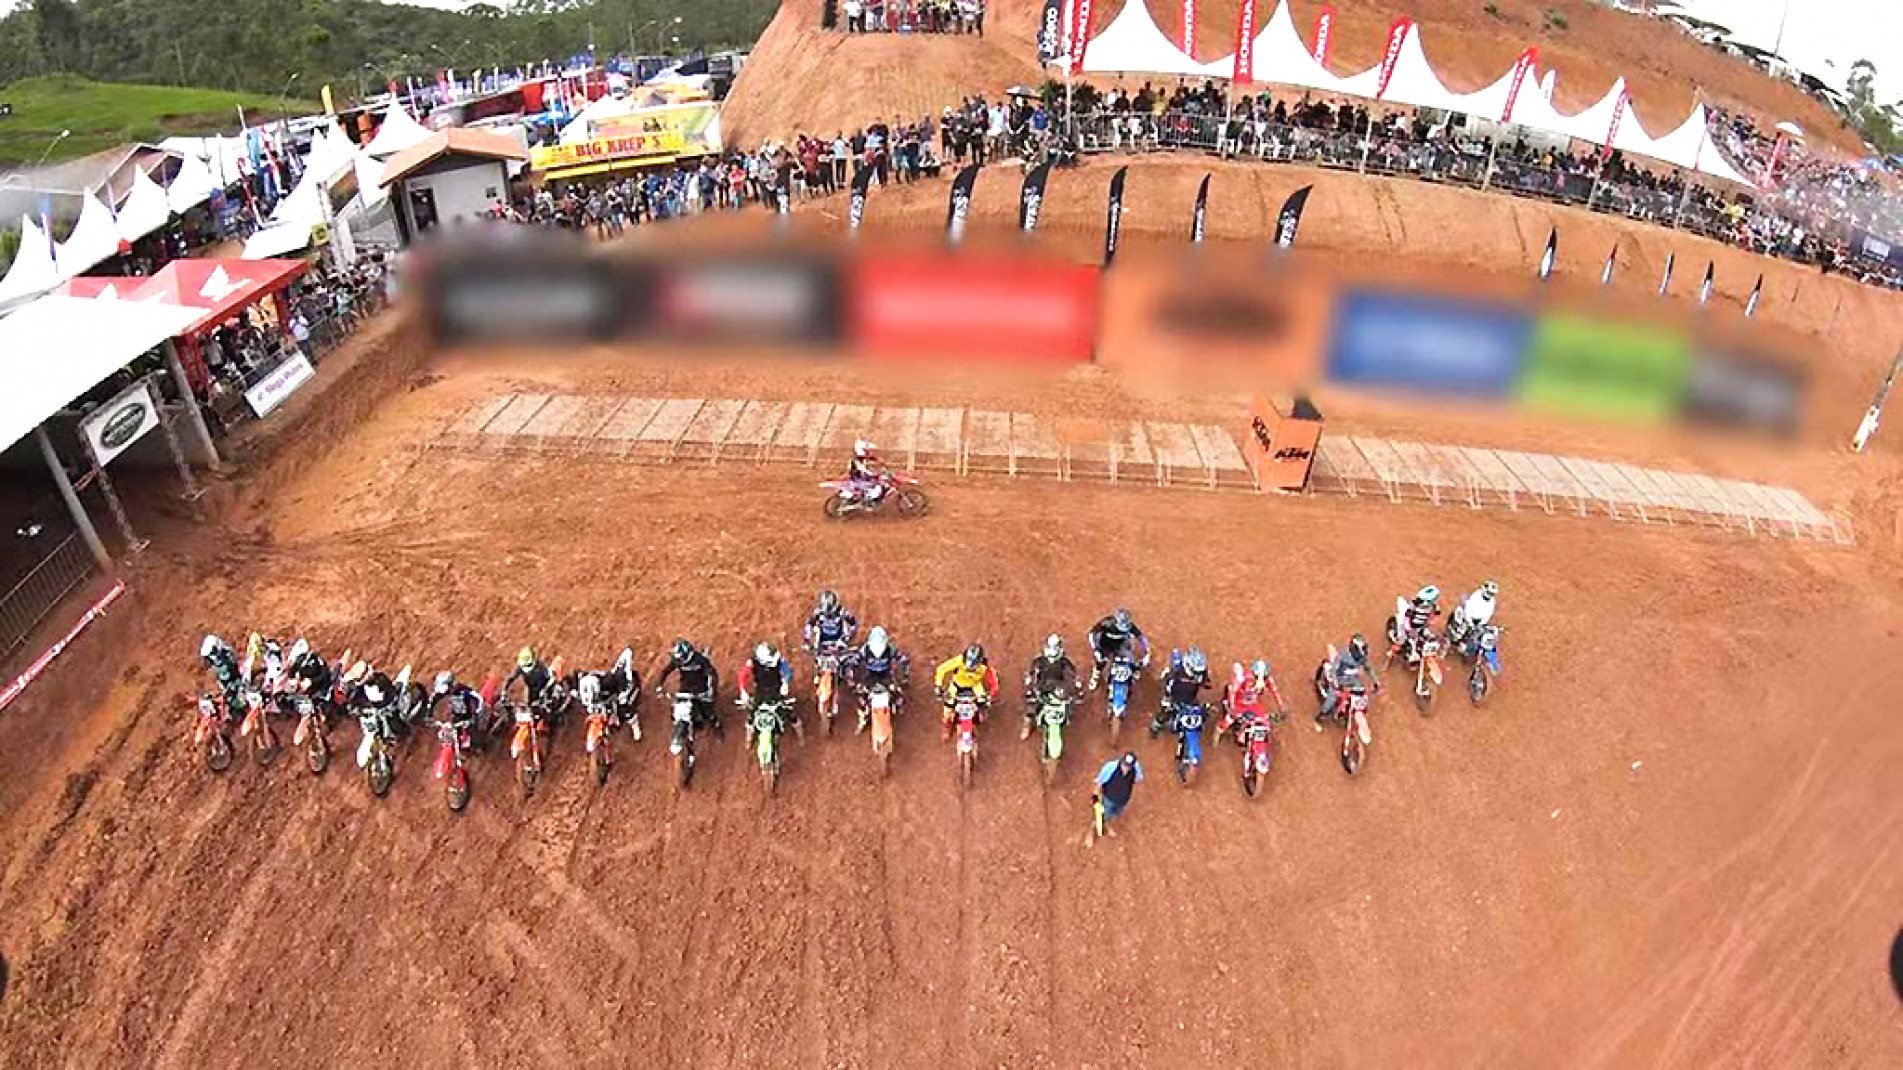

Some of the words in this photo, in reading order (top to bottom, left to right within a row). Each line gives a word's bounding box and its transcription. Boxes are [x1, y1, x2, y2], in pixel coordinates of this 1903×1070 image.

[1072, 0, 1090, 63] HOND
[1239, 0, 1252, 74] HONDA
[1315, 14, 1330, 63] ONDA
[575, 142, 602, 156] BIG
